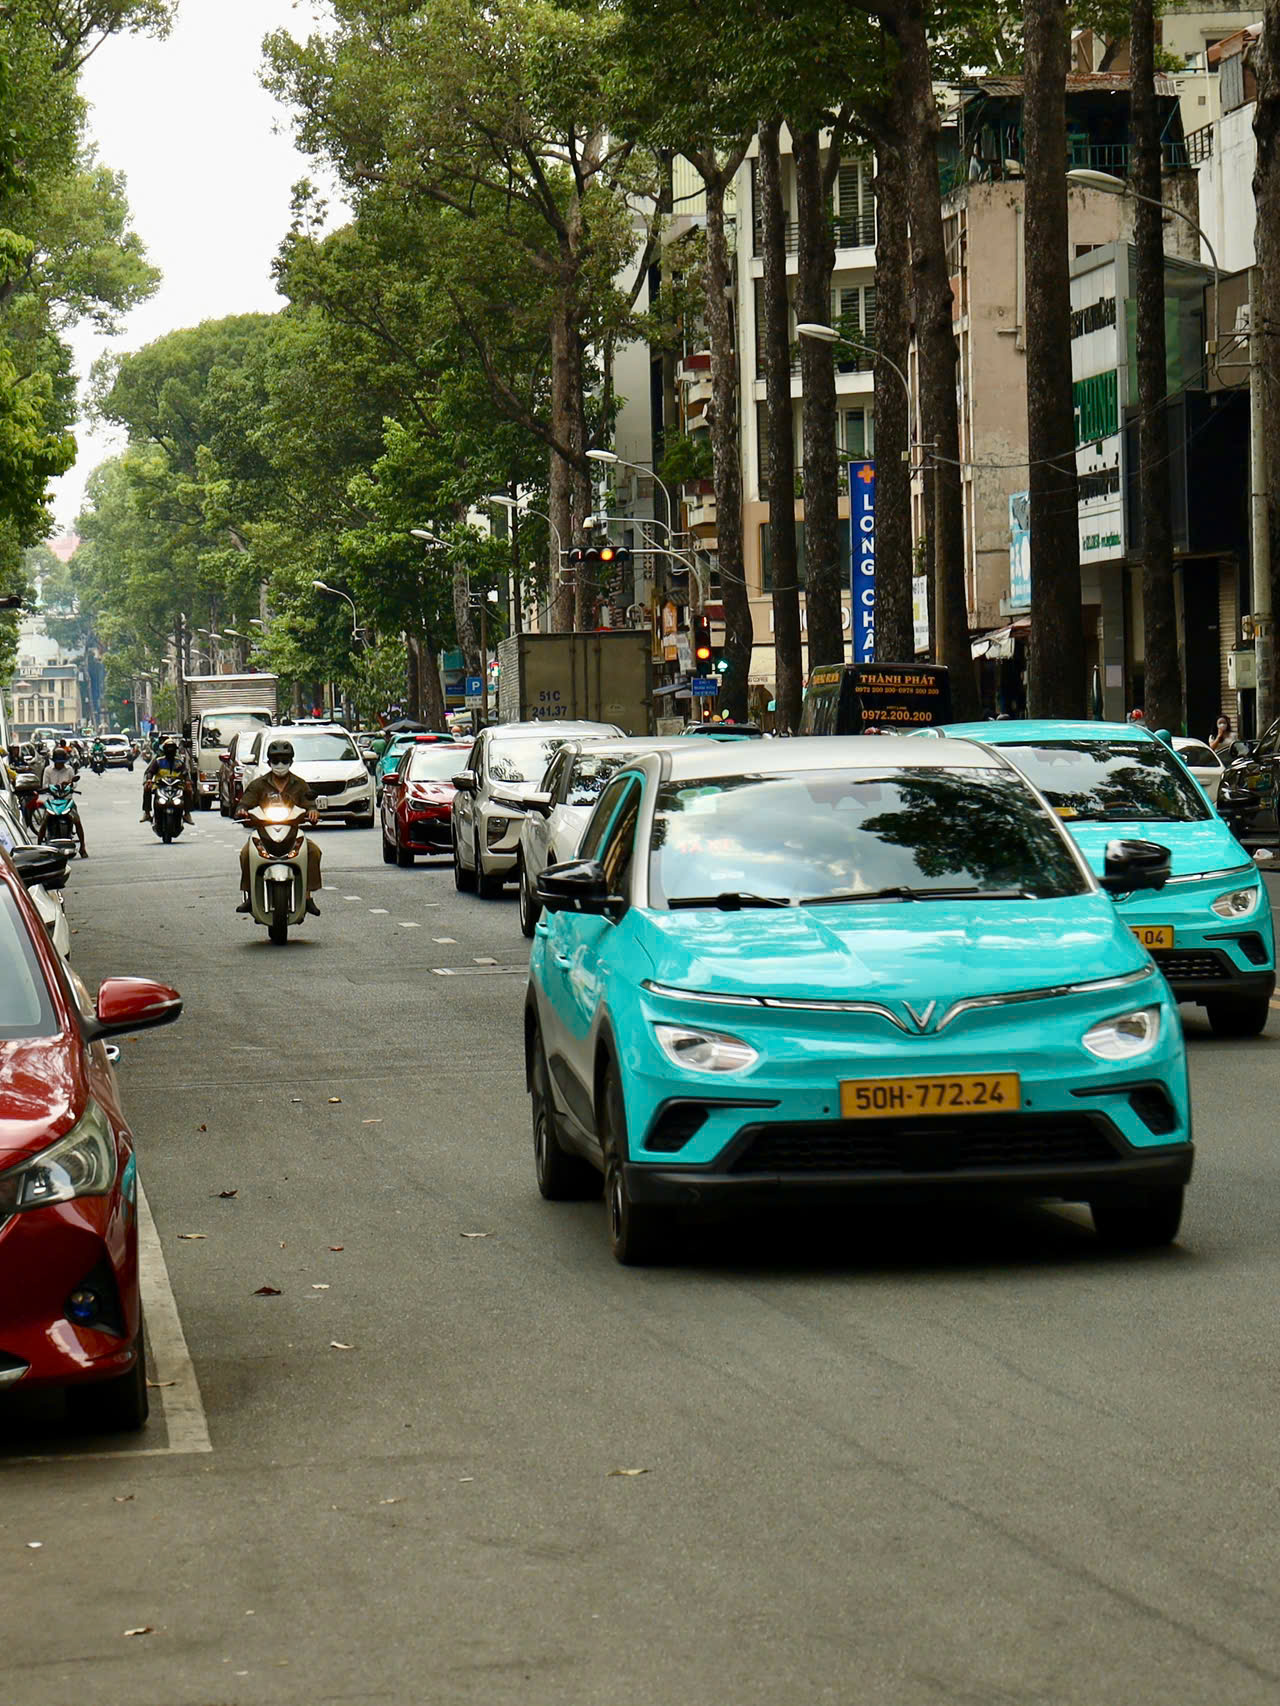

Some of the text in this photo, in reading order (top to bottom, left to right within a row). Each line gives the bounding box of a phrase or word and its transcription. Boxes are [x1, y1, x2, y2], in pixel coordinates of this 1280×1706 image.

[860, 673, 936, 685] THÀNH PHÁT
[472, 681, 480, 691] P
[539, 691, 561, 702] 51C
[531, 705, 568, 718] 241.37
[861, 710, 933, 722] 0972.200.200
[855, 1081, 1004, 1111] 50H-772.24
